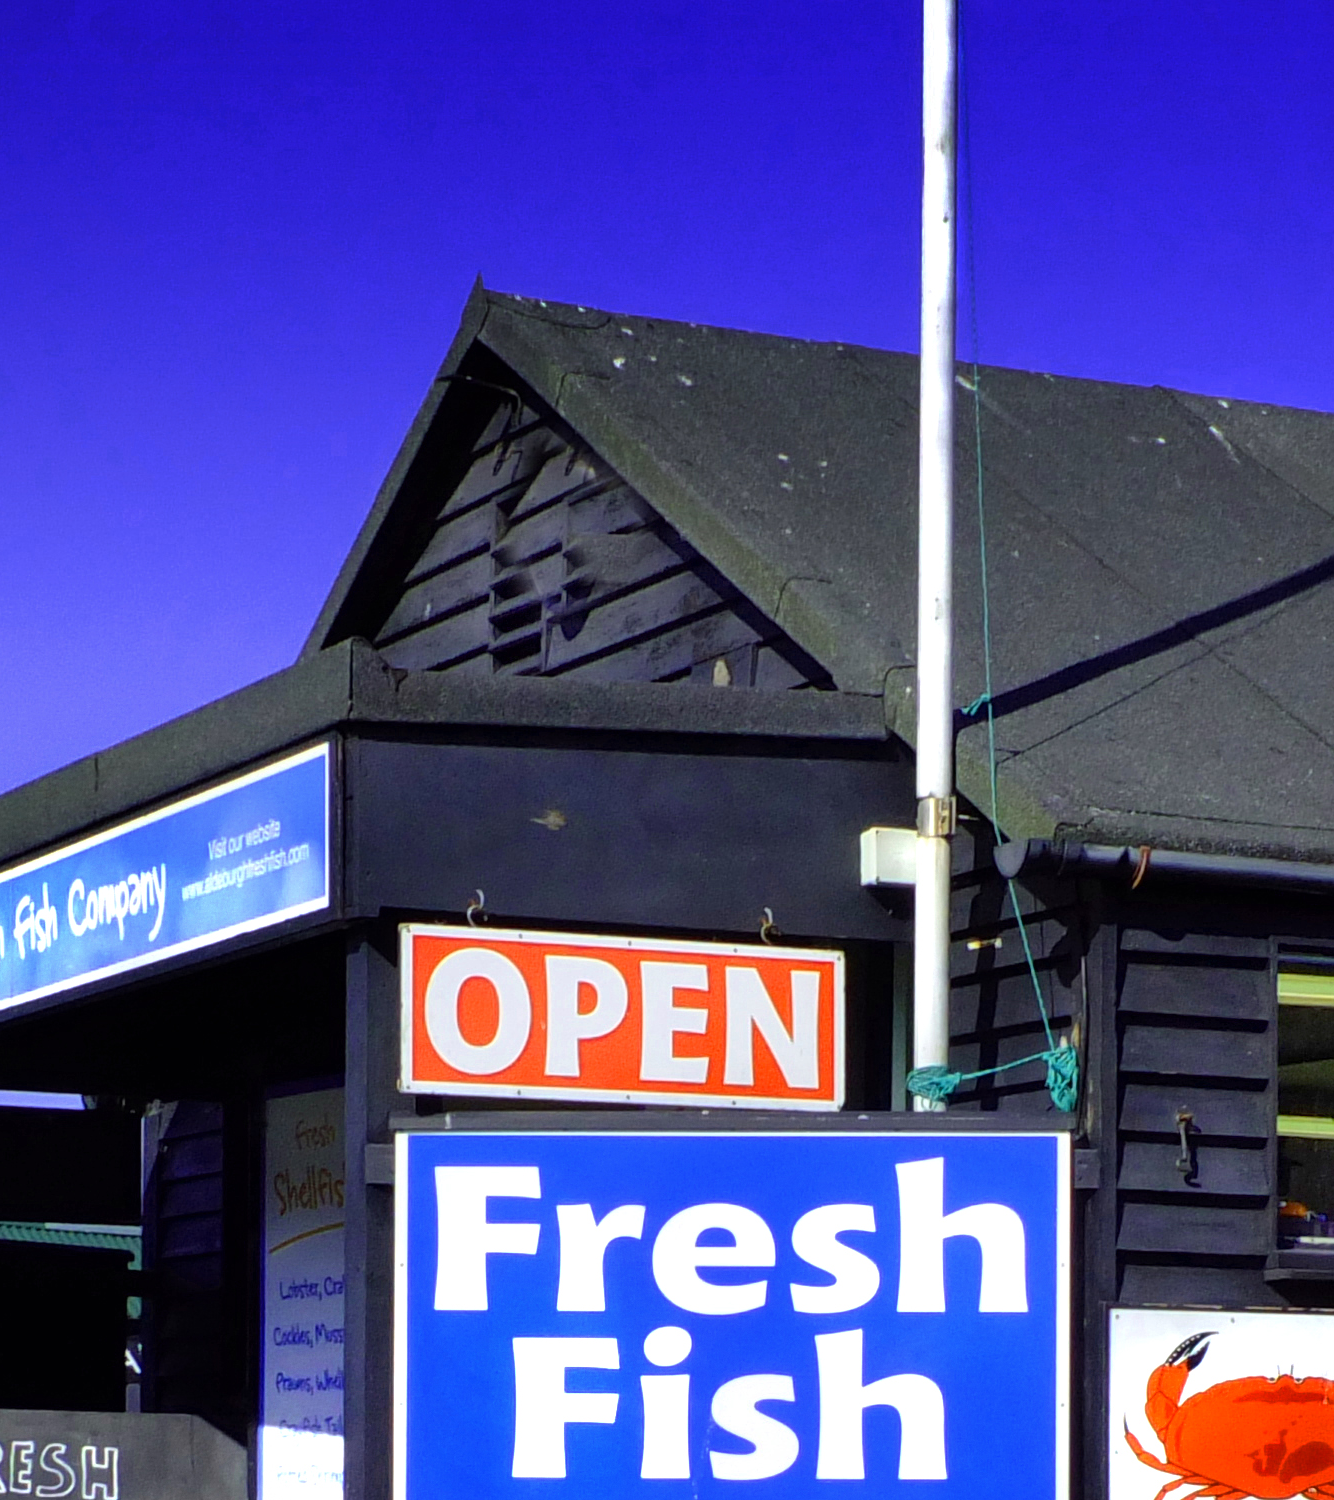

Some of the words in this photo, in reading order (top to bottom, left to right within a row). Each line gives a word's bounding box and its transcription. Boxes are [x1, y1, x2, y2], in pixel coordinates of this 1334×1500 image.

[13, 881, 59, 960] Fish
[68, 862, 166, 943] Company
[424, 948, 821, 1089] OPEN
[433, 1157, 1028, 1316] Fresh
[512, 1326, 948, 1480] Fish
